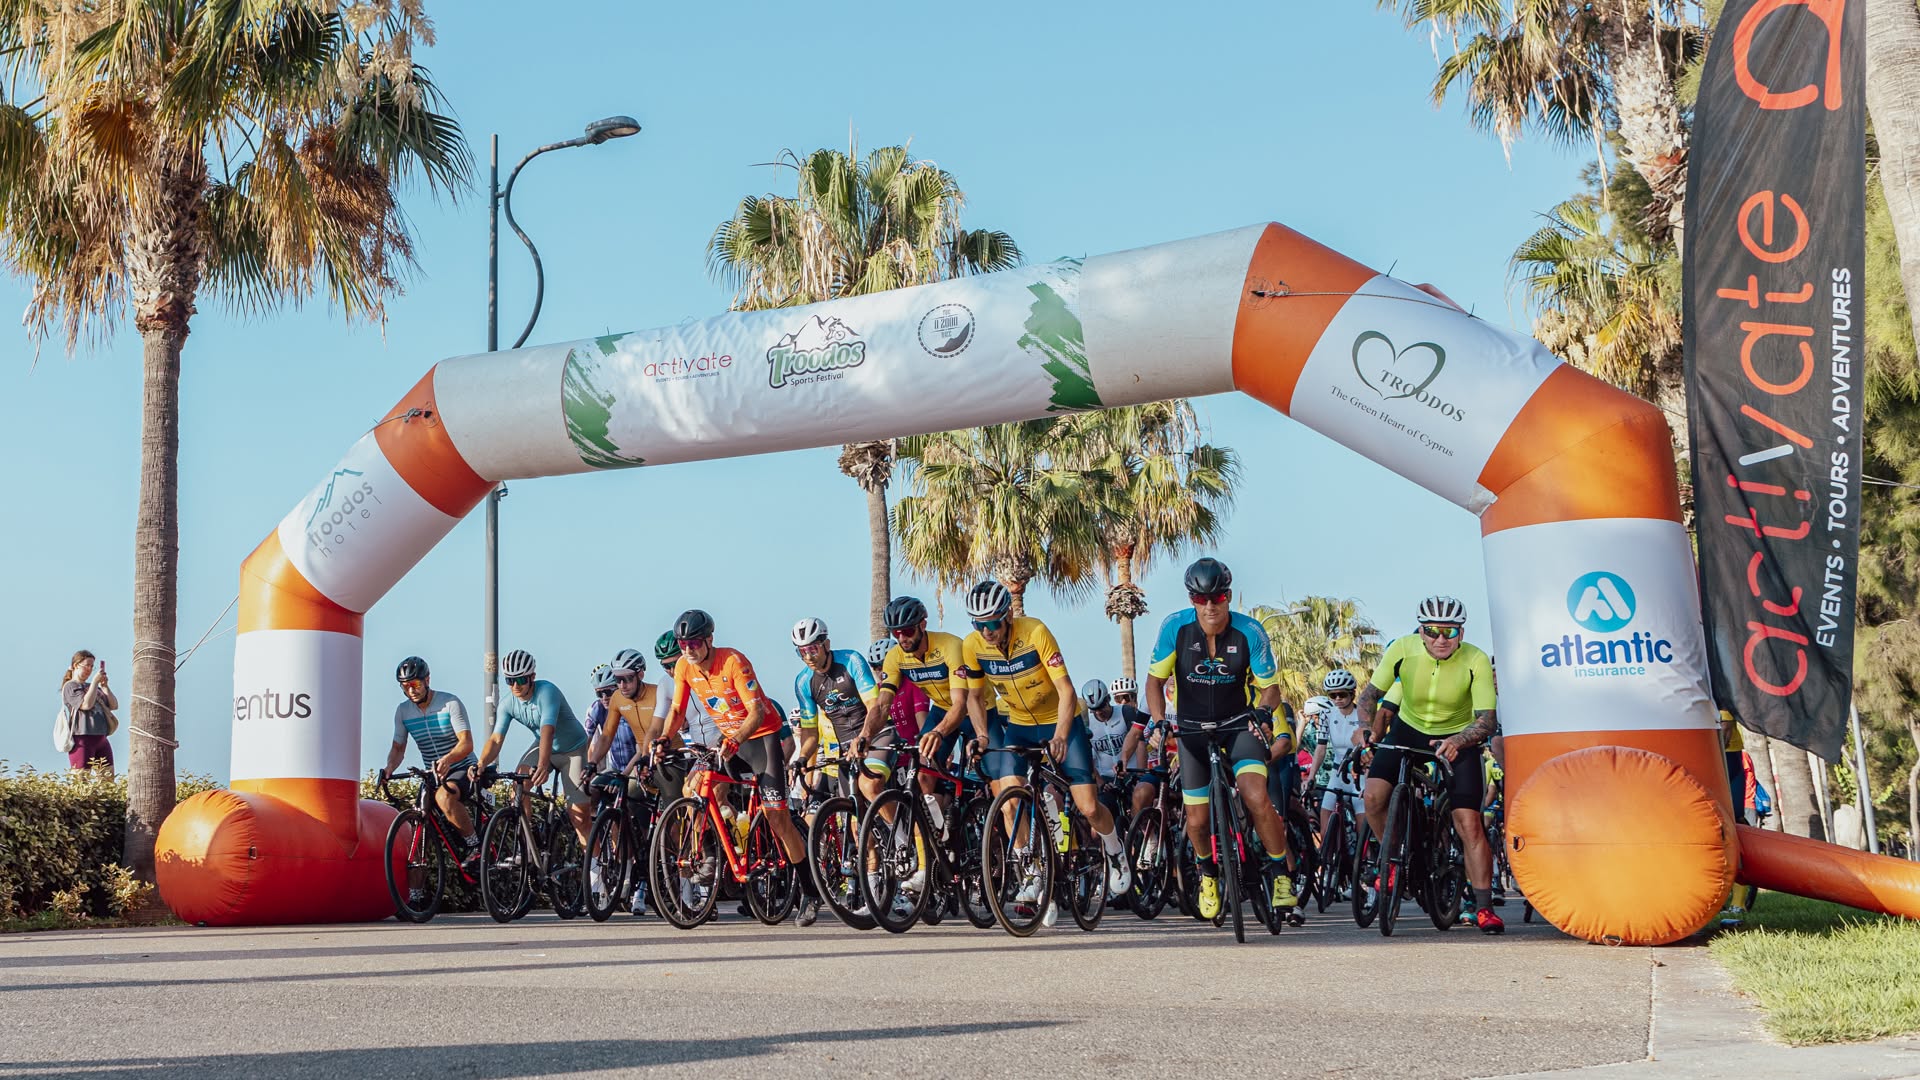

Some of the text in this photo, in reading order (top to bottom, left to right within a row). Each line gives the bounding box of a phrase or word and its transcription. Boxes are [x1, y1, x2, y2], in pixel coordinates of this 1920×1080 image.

[643, 352, 732, 377] activate
[768, 342, 865, 388] Troodos
[790, 371, 844, 386] Sports Festival
[1379, 369, 1466, 422] TROODOS
[1331, 385, 1454, 457] The Green Heart of Cyprus
[1716, 190, 1815, 697] activate
[1816, 267, 1852, 648] EVENTS TOURS ADVENTURES
[1541, 631, 1673, 668] atlantic
[1574, 666, 1646, 678] insurance
